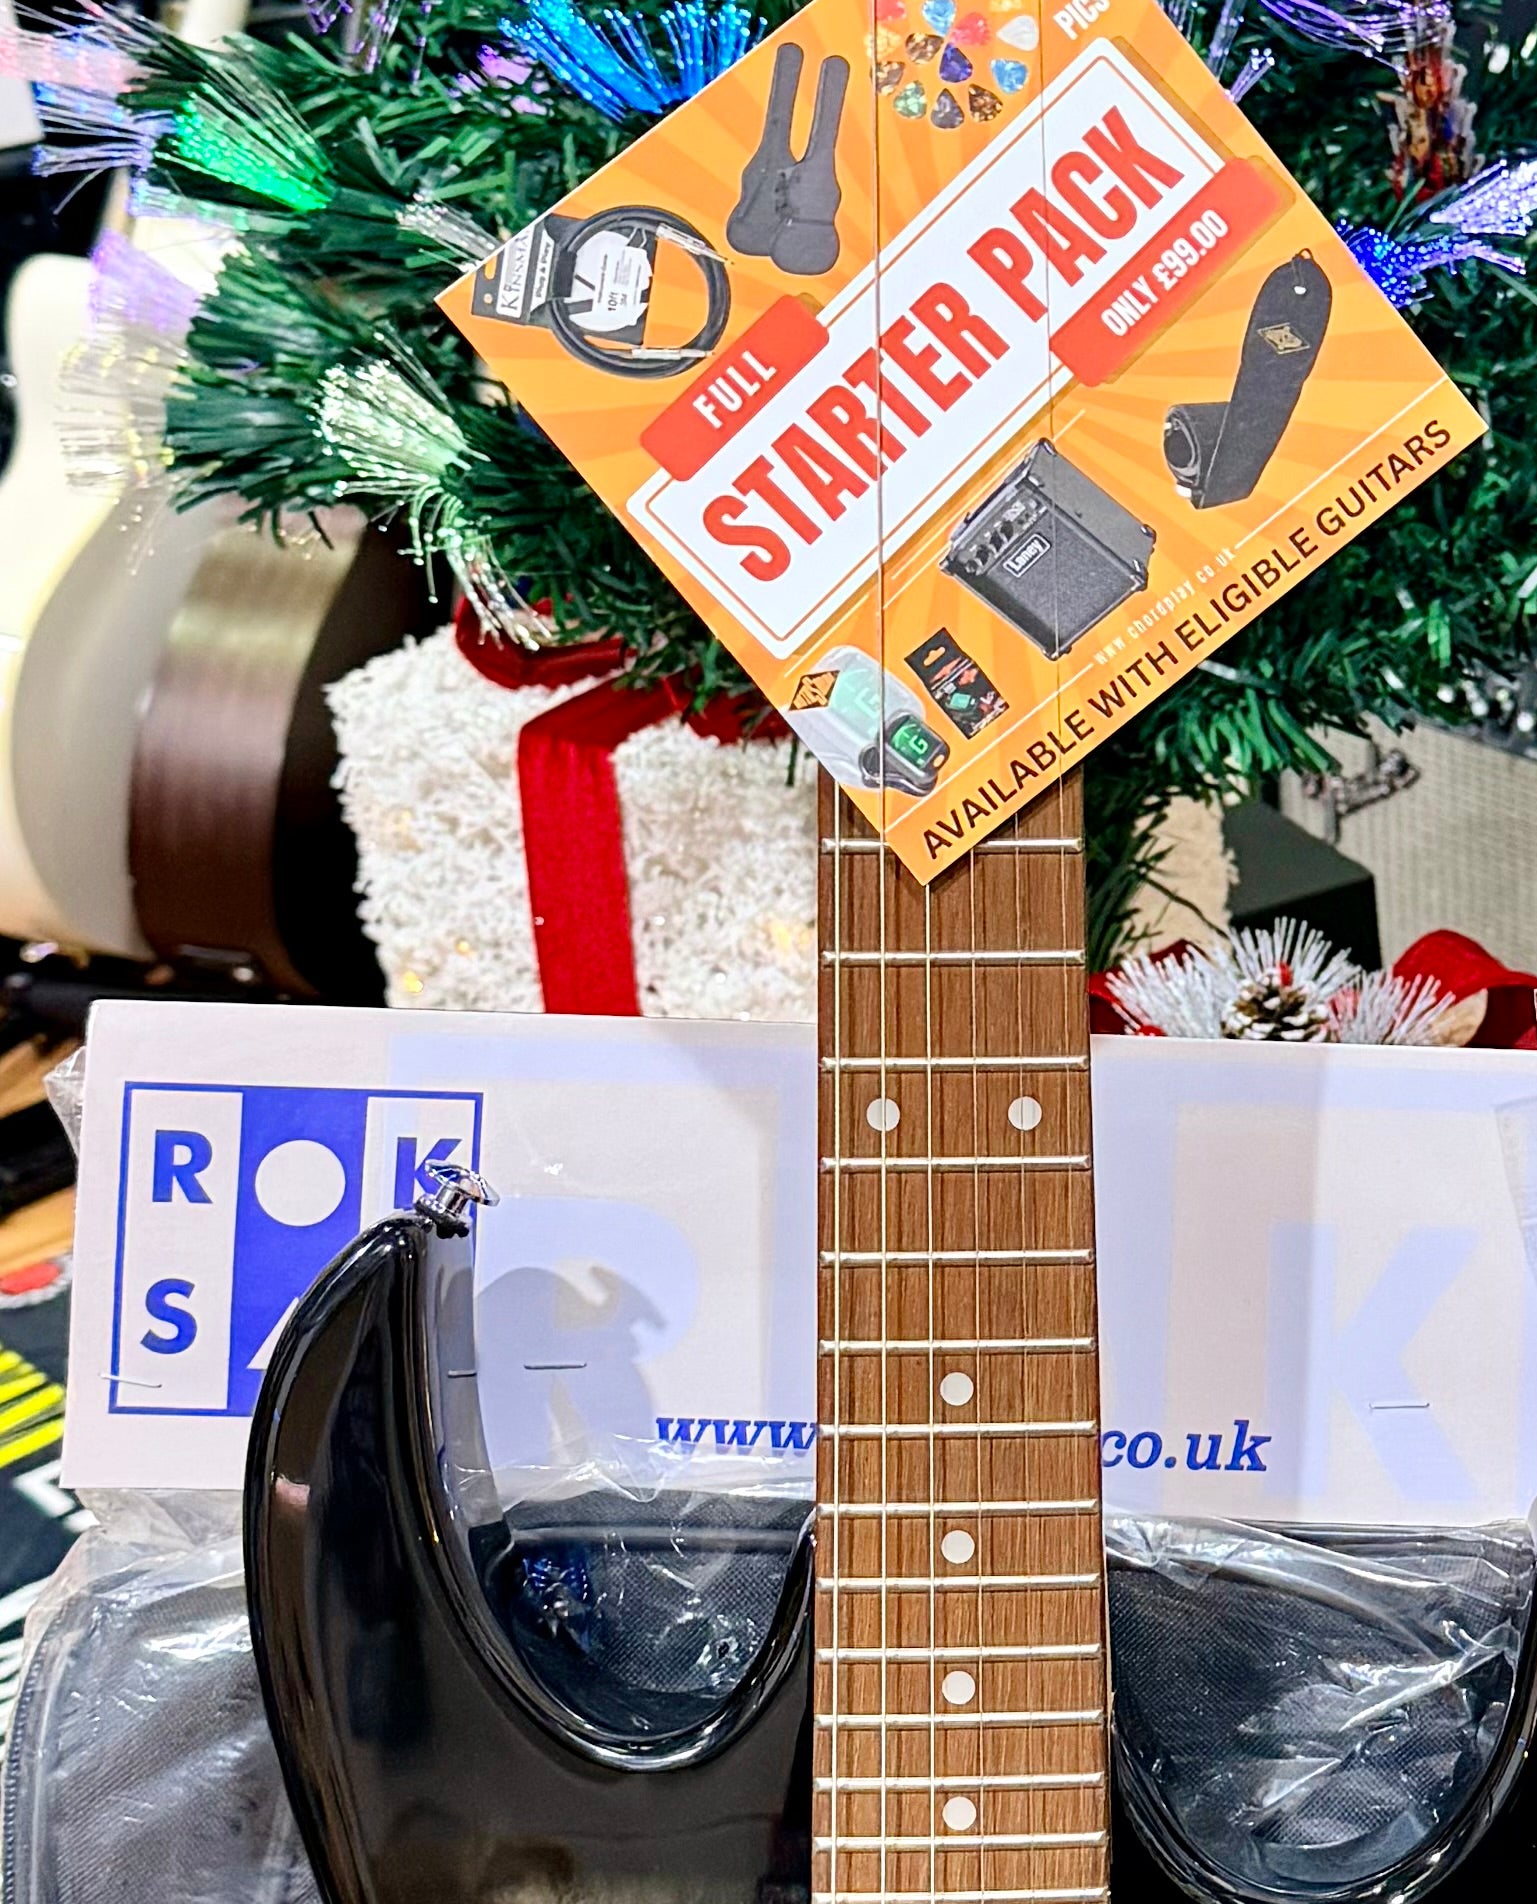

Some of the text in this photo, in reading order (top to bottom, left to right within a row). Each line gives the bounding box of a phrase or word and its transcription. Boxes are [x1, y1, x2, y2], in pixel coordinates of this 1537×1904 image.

[499, 227, 532, 311] KINSMA
[1100, 207, 1229, 337] ONLY £99.00
[692, 350, 777, 431] FULL
[703, 104, 1185, 582] STARTER PACK
[1011, 540, 1043, 572] Laney
[921, 418, 1454, 862] AVAILABLE WITH ELIGIBLE GUITARS
